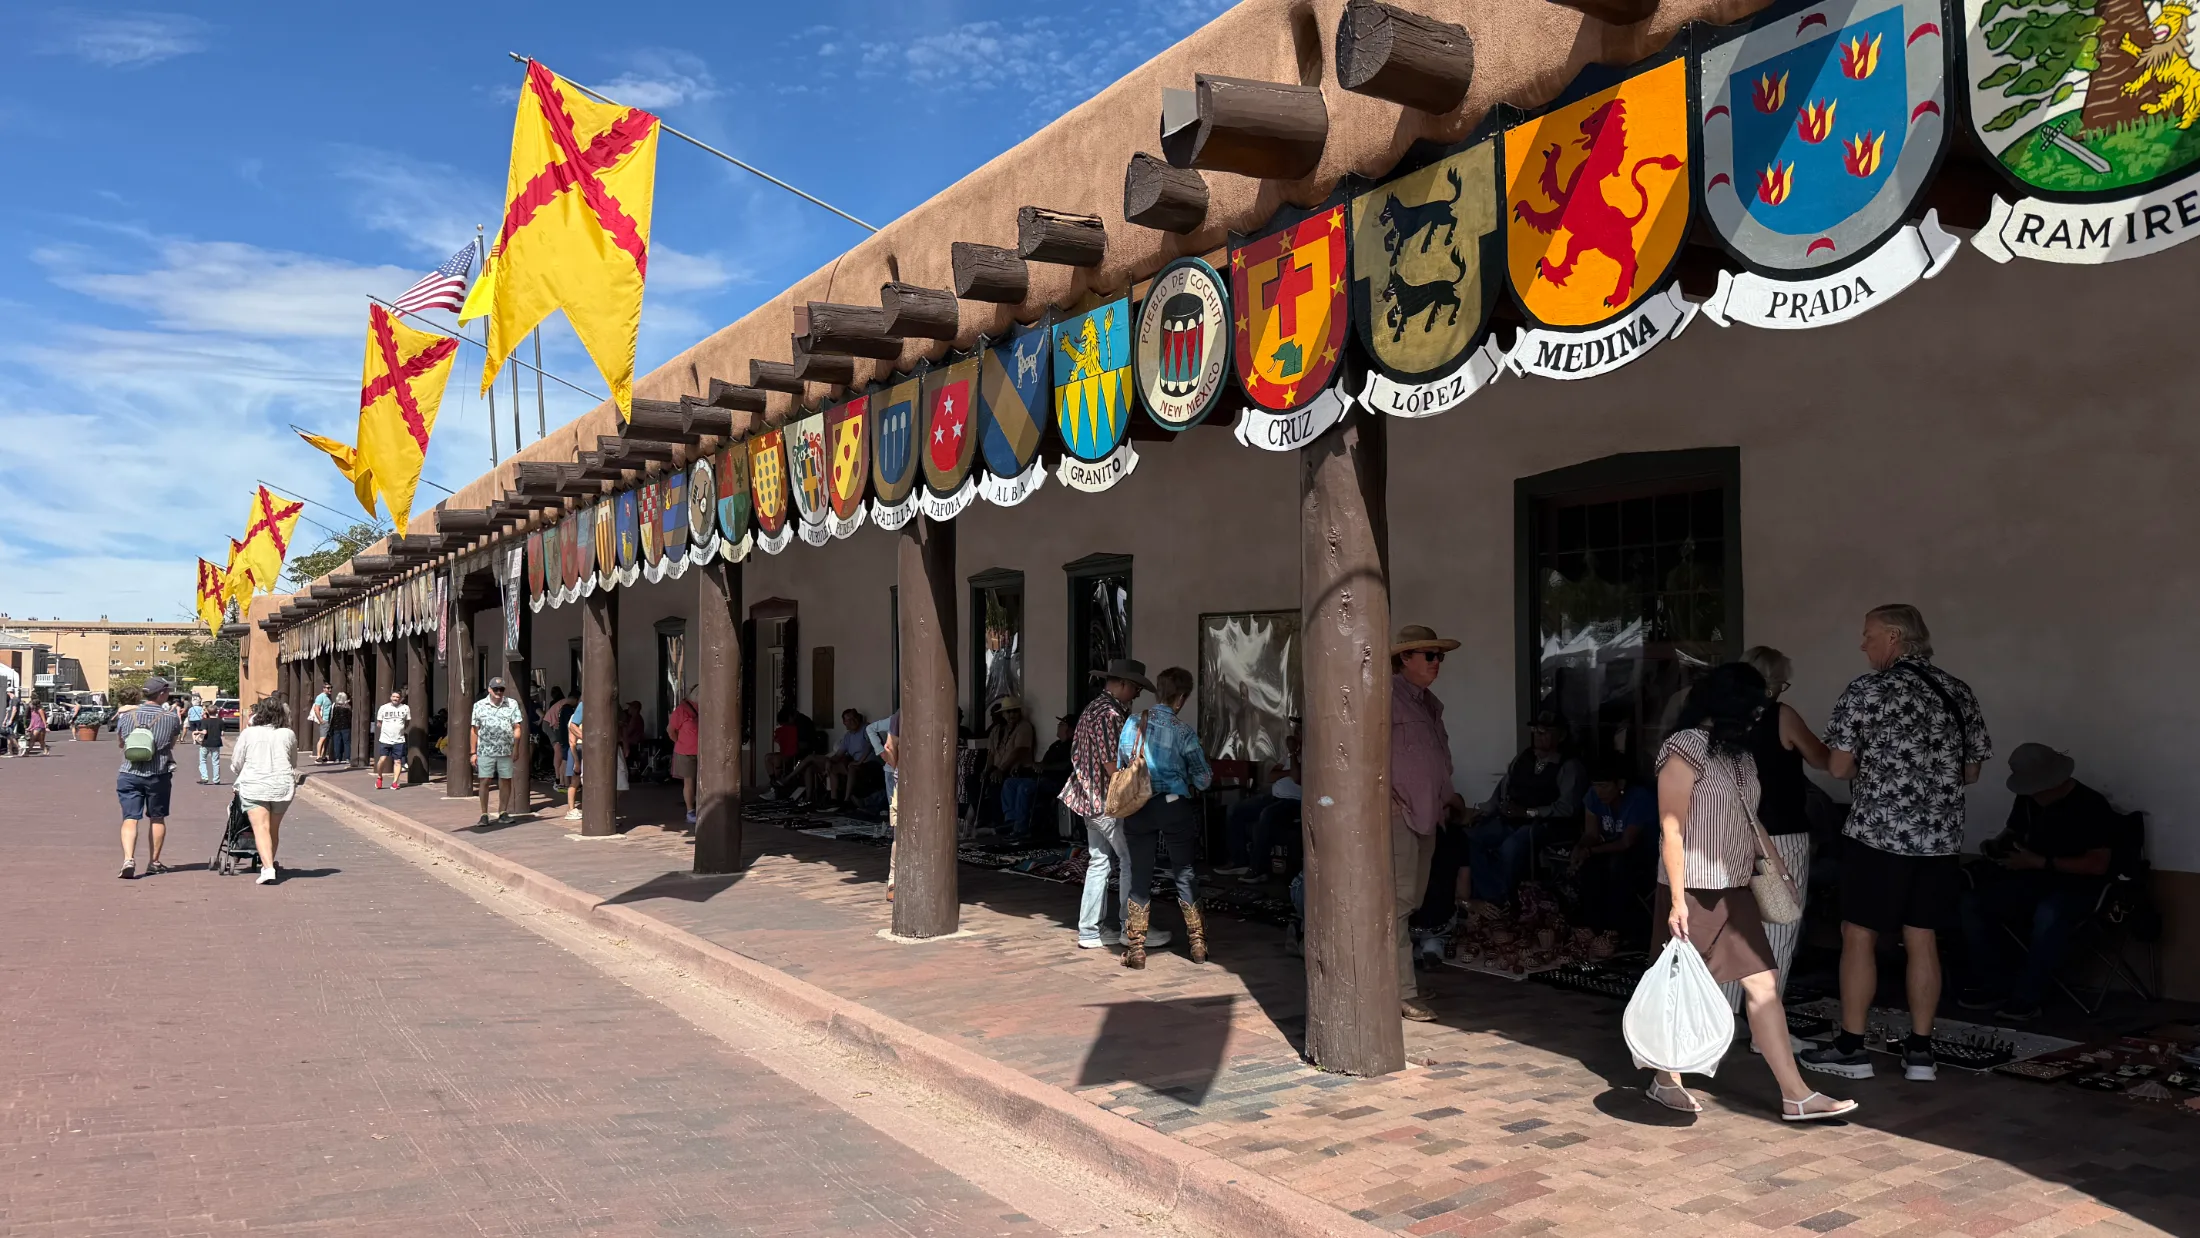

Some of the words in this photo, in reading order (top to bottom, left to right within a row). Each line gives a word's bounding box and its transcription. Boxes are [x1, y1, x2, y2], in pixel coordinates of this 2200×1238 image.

[1142, 285, 1167, 344] PUEBLO
[1172, 273, 1184, 290] DE
[1190, 274, 1222, 326] COCHITI
[1764, 276, 1877, 323] PRADA
[1534, 313, 1660, 373] MEDINA
[1160, 400, 1183, 418] NEW
[1186, 362, 1220, 415] MEXICO
[1391, 376, 1466, 413] LÓPEZ
[1268, 409, 1315, 447] CRUZ
[1071, 458, 1121, 485] GRANITO
[930, 497, 961, 517] TAFOYA
[994, 482, 1026, 502] ALBA
[876, 503, 912, 526] PADILLA
